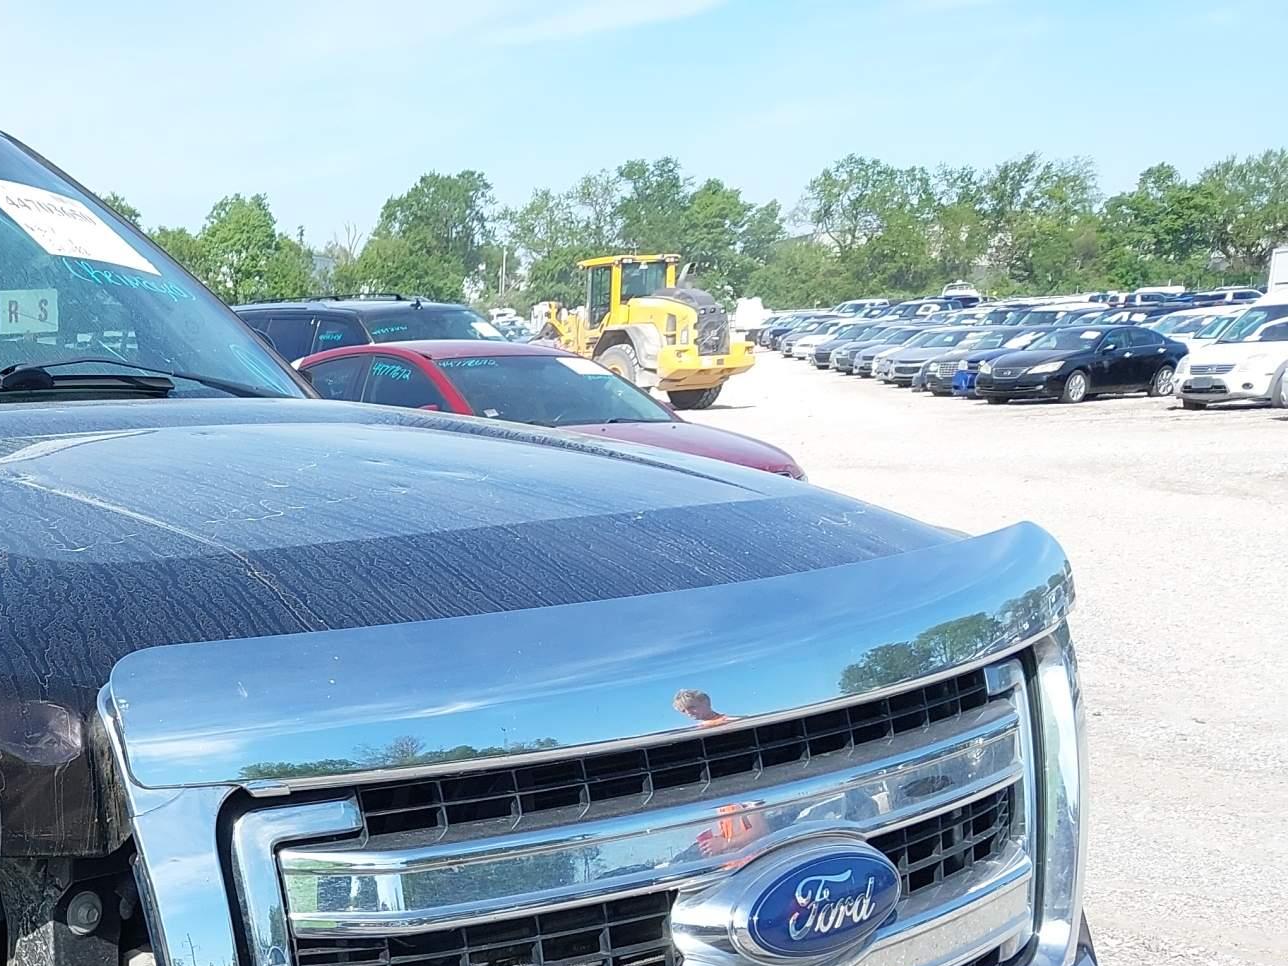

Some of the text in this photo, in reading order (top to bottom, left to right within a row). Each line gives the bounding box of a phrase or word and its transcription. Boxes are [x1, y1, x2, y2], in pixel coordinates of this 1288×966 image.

[8, 298, 48, 323] R S
[789, 869, 876, 940] Ford
